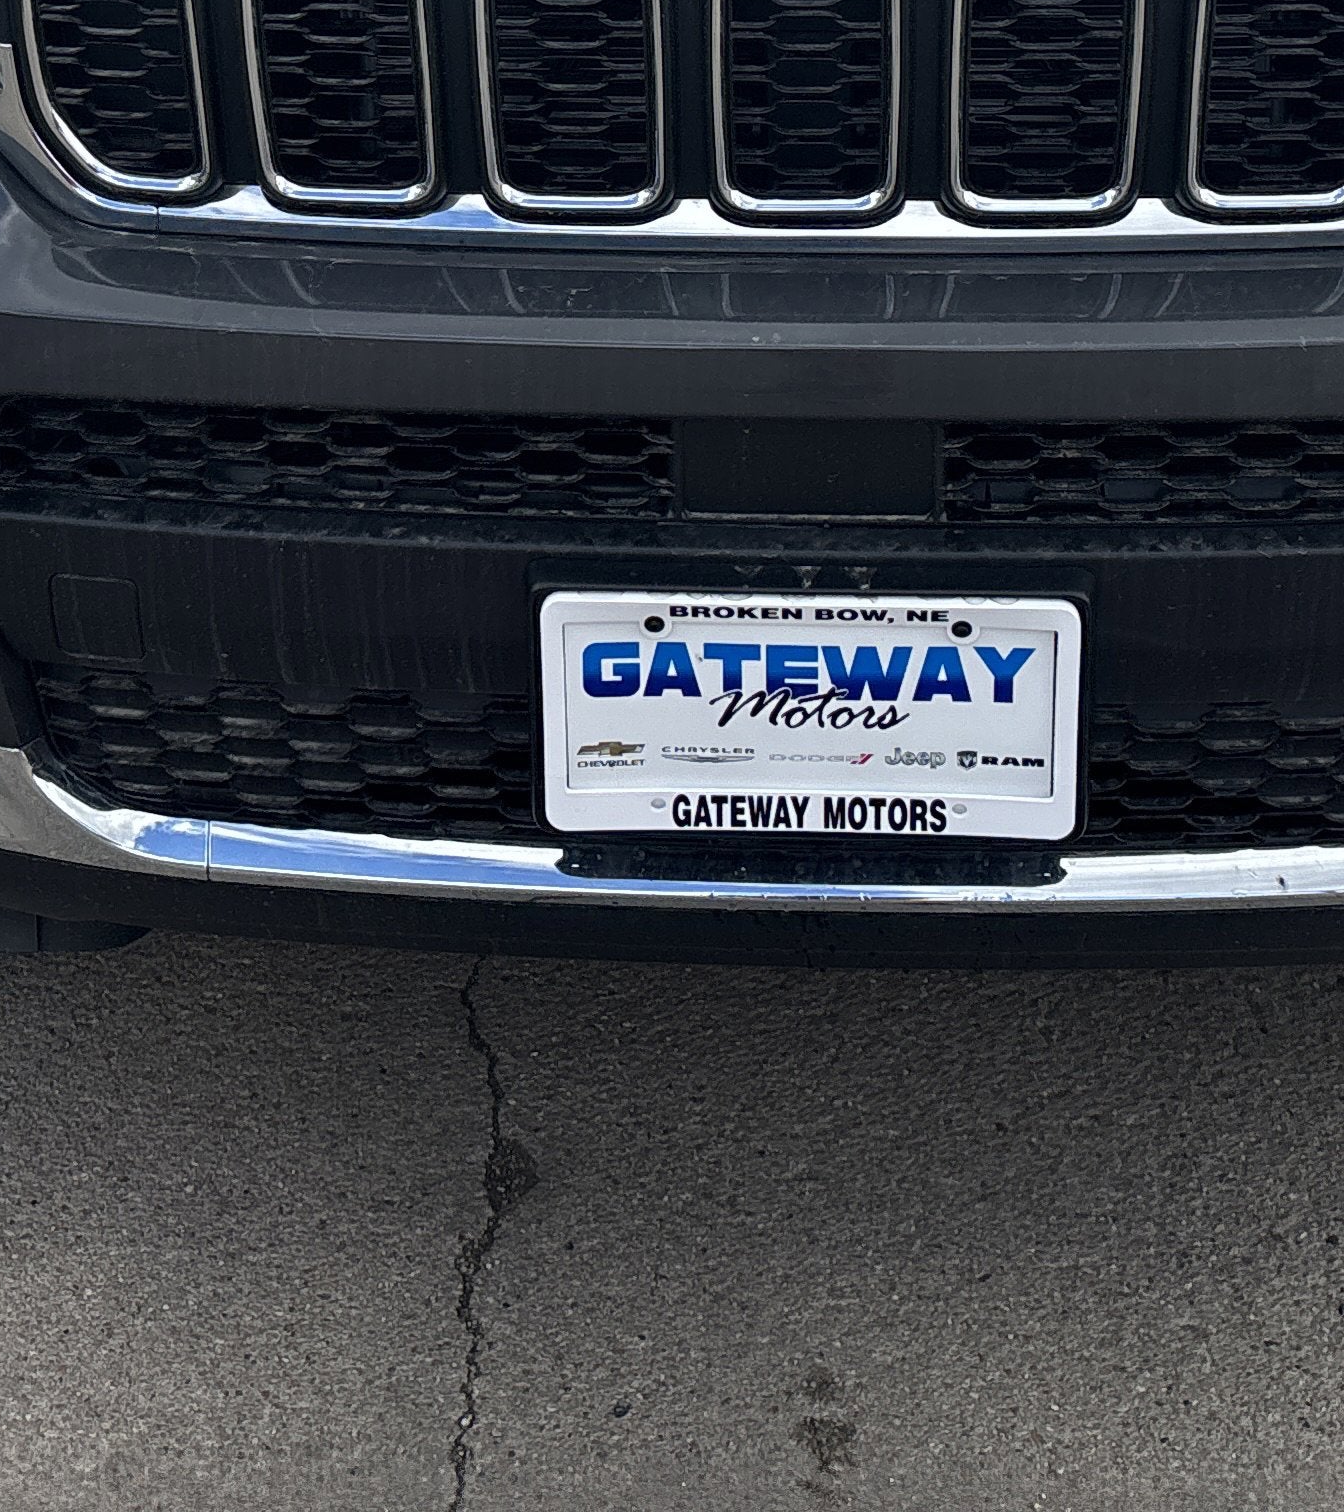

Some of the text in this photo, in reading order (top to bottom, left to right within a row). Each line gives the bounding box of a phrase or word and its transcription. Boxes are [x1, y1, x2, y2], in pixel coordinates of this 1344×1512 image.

[669, 605, 950, 624] BROKEN BOW, NE
[582, 641, 1037, 704] GATEWAY
[708, 686, 910, 730] Motors
[661, 745, 755, 755] CHRYSLER
[884, 746, 947, 770] Jeep
[577, 758, 646, 769] CHEVROLET
[980, 755, 1045, 768] RAM
[672, 793, 948, 833] GATEWAY MOTORS
